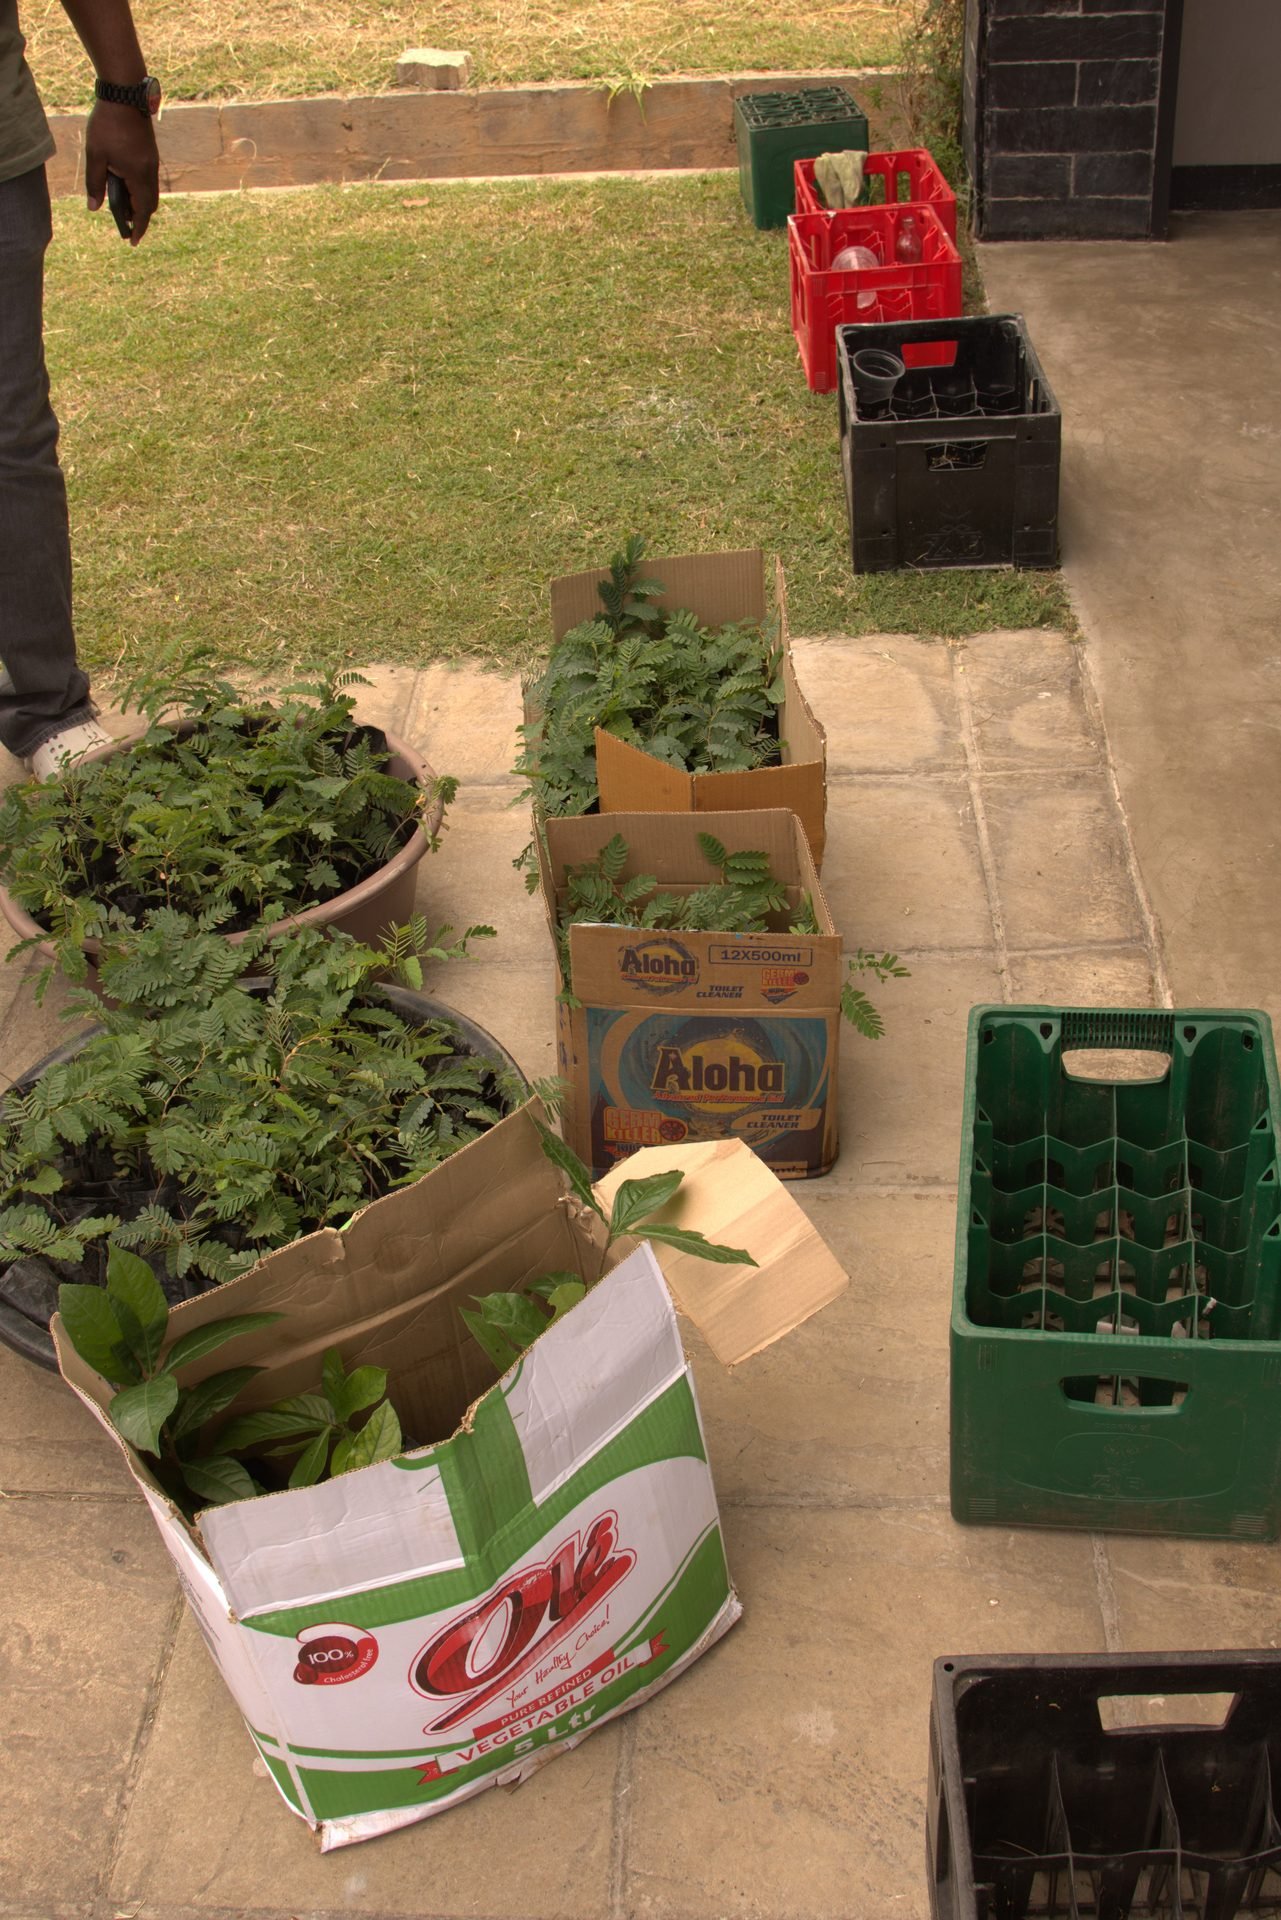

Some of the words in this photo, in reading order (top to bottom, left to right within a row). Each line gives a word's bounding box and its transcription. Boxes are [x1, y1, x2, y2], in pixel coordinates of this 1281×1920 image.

[621, 948, 696, 976] Aloha
[720, 949, 801, 962] 12X500ml
[763, 969, 795, 980] GERM
[652, 1047, 784, 1093] Aloha
[606, 1108, 661, 1128] GERM
[746, 1121, 799, 1129] CLEANER
[606, 1126, 661, 1143] KILLER
[506, 1686, 529, 1708] Your
[535, 1652, 572, 1685] Healthy
[575, 1603, 610, 1651] Choice!
[324, 1661, 368, 1683] Cholesterol
[455, 1681, 595, 1762] VEGETABLE
[600, 1656, 635, 1684] OIL
[500, 1704, 536, 1726] PURE
[538, 1669, 592, 1706] REFINED
[513, 1738, 534, 1756] 5
[547, 1703, 597, 1741] Ltr
